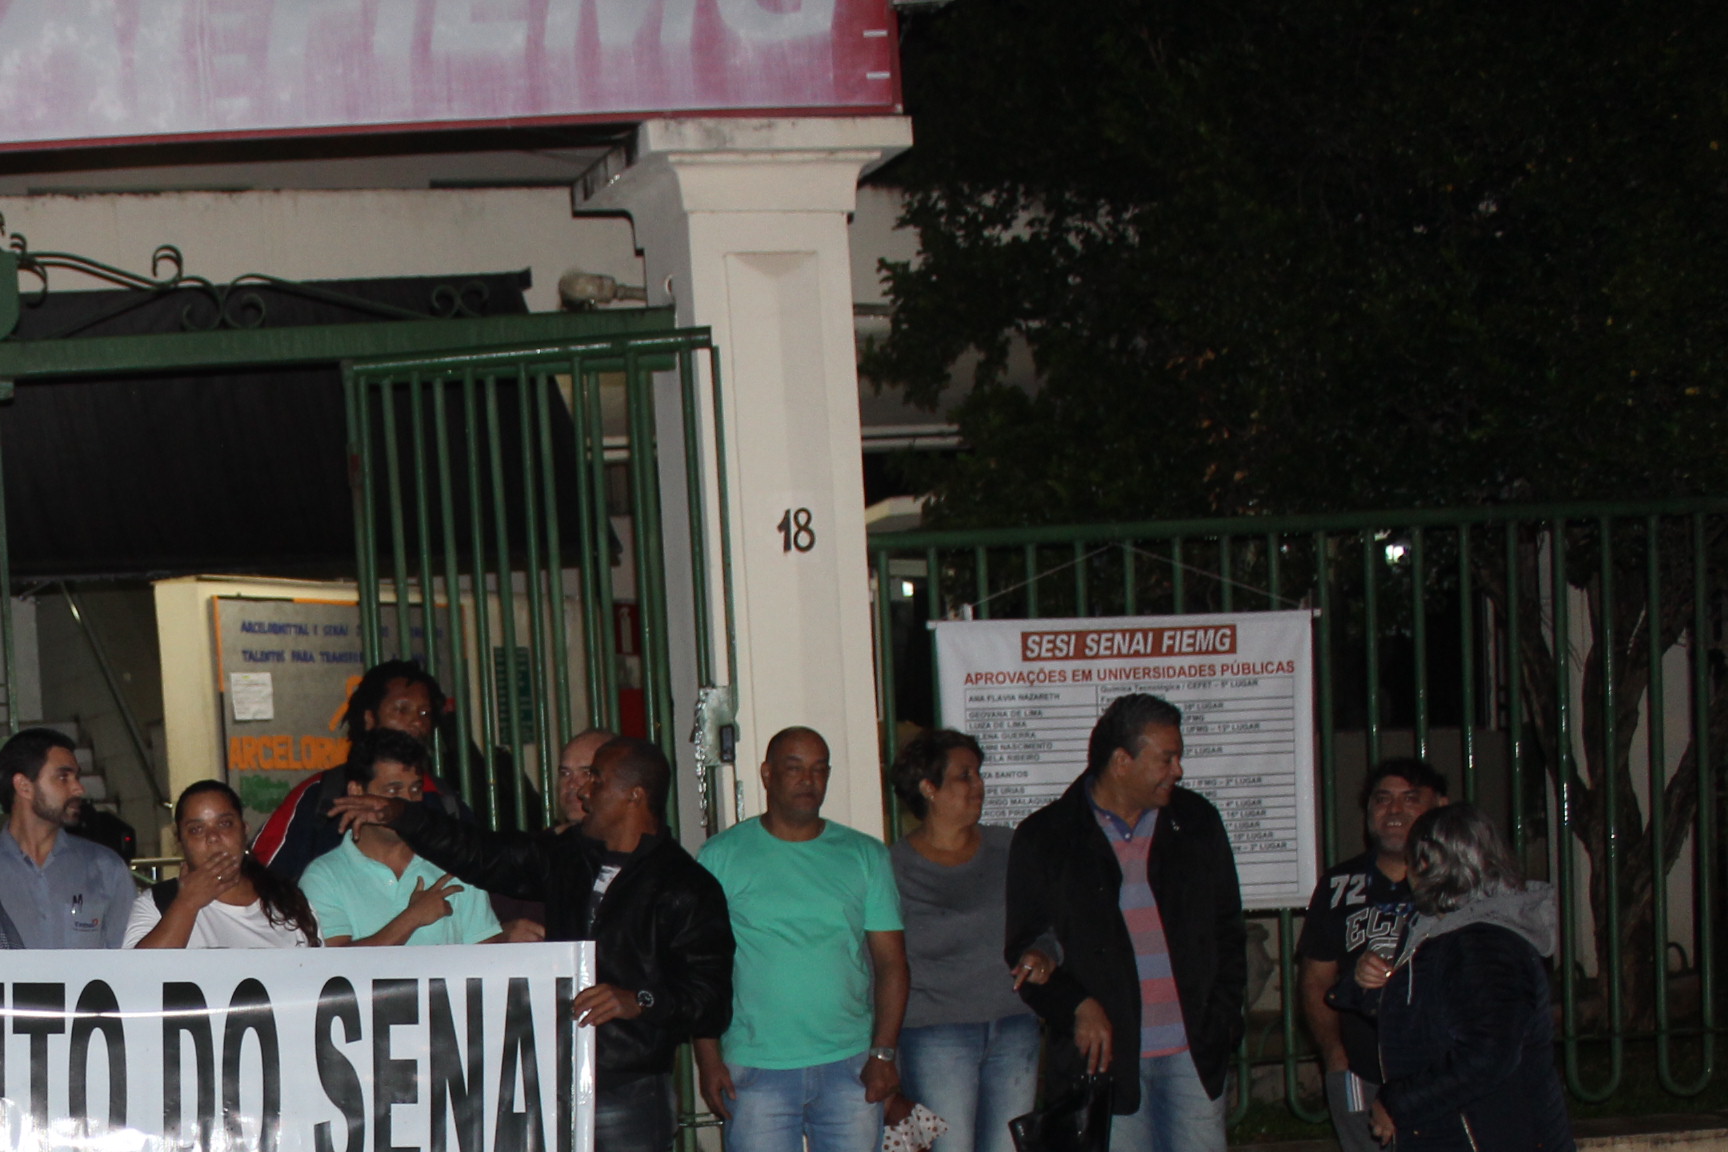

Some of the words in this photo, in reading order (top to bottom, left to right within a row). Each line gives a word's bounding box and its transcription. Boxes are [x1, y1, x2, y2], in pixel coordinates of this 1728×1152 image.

[777, 507, 815, 553] 18
[1026, 633, 1076, 659] SESI
[1084, 630, 1154, 657] SENAI
[1161, 627, 1232, 654] FIEMG
[964, 669, 1067, 687] APROVAÇÕES
[1072, 669, 1093, 682] EM
[1097, 664, 1216, 681] UNIVERSIDADES
[1221, 660, 1295, 677] PÚBLICAS
[1329, 873, 1366, 909] 72
